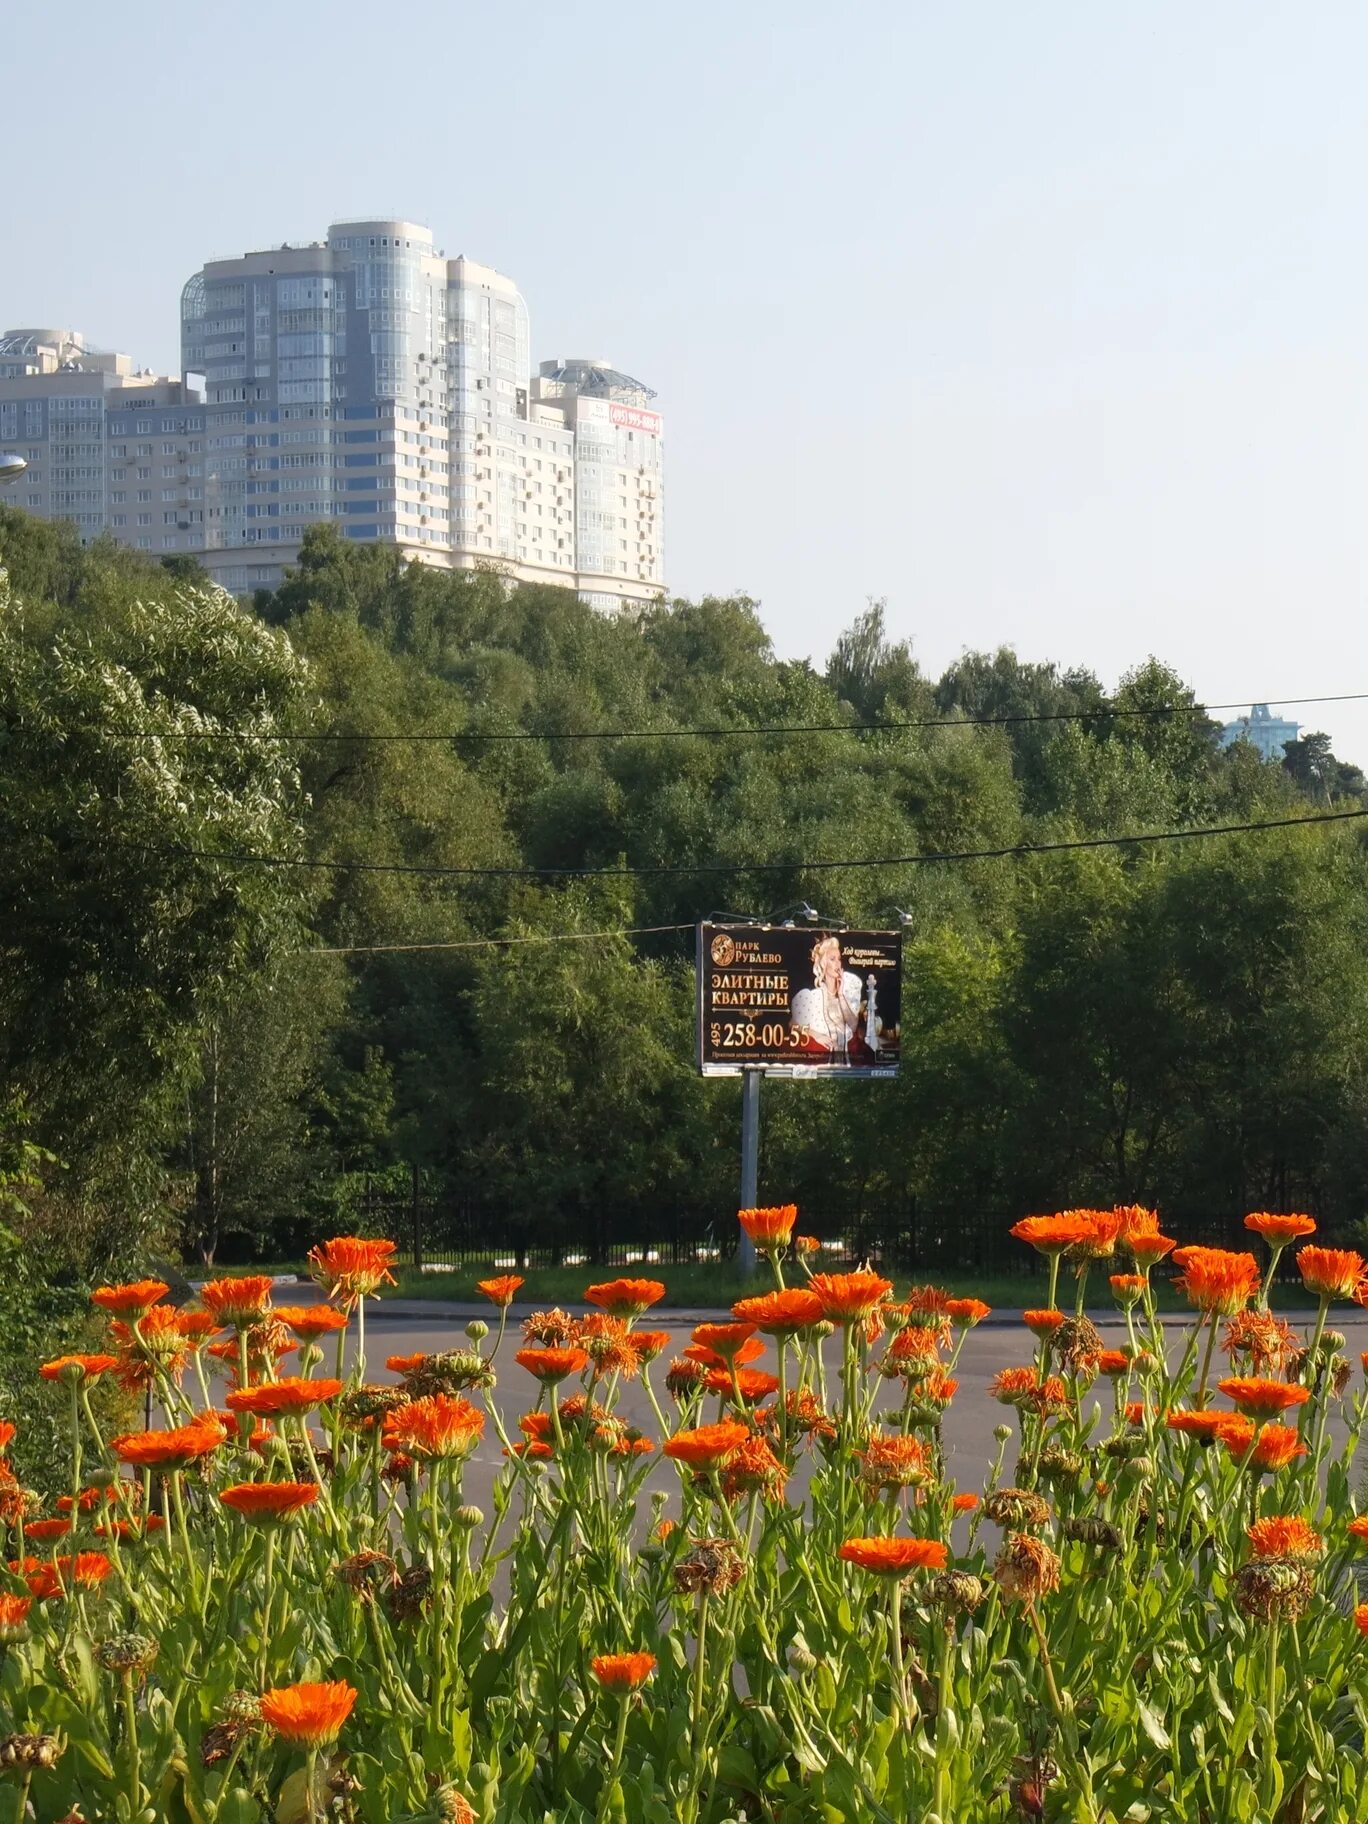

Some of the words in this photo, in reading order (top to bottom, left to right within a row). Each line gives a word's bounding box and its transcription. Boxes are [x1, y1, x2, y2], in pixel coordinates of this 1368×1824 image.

[735, 942, 759, 951] ПАРК
[735, 951, 782, 963] РУБЛЕВО
[711, 975, 789, 990] ЭЛИТНЫЕ
[711, 991, 789, 1006] КВАРТИРЫ
[711, 1022, 721, 1047] 495
[723, 1023, 810, 1047] 258-00-55
